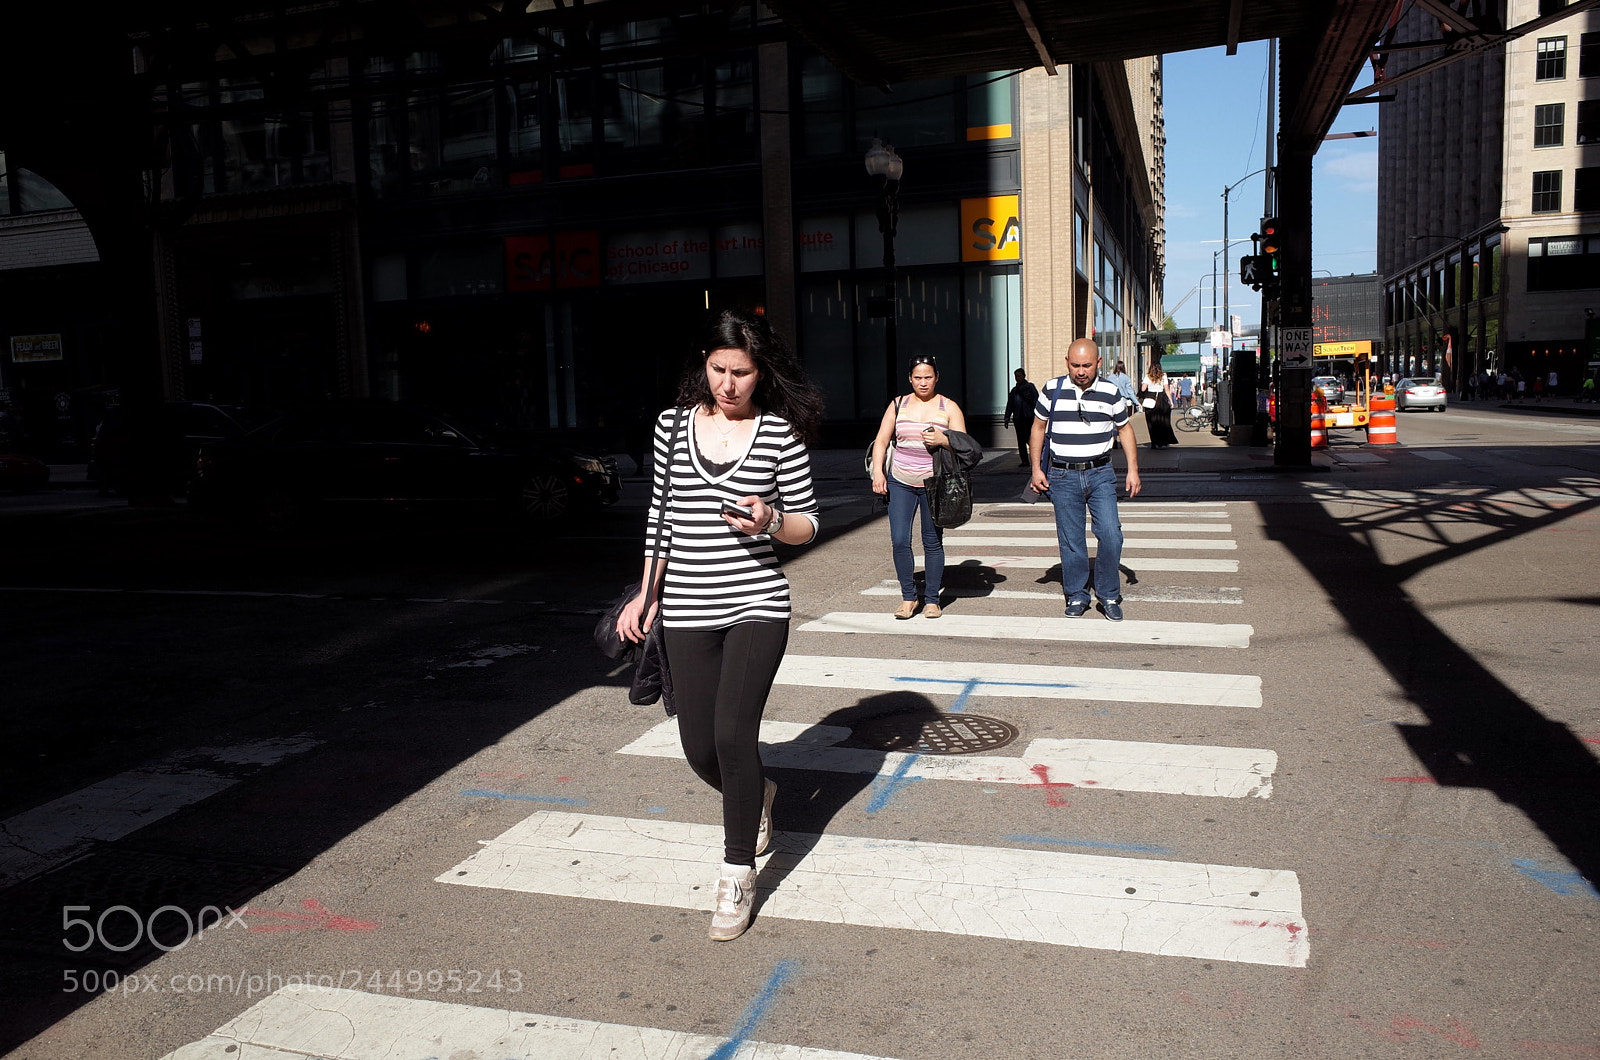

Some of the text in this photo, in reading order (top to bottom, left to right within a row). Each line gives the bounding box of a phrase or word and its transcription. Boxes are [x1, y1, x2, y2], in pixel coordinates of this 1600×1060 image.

[972, 216, 1019, 251] SA
[606, 242, 659, 259] School
[662, 240, 679, 255] of
[682, 238, 708, 253] the
[713, 236, 738, 252] Art
[513, 247, 594, 282] SAIC
[606, 258, 690, 277] of Chicago
[1285, 330, 1310, 341] ONE
[1285, 342, 1311, 352] WAY
